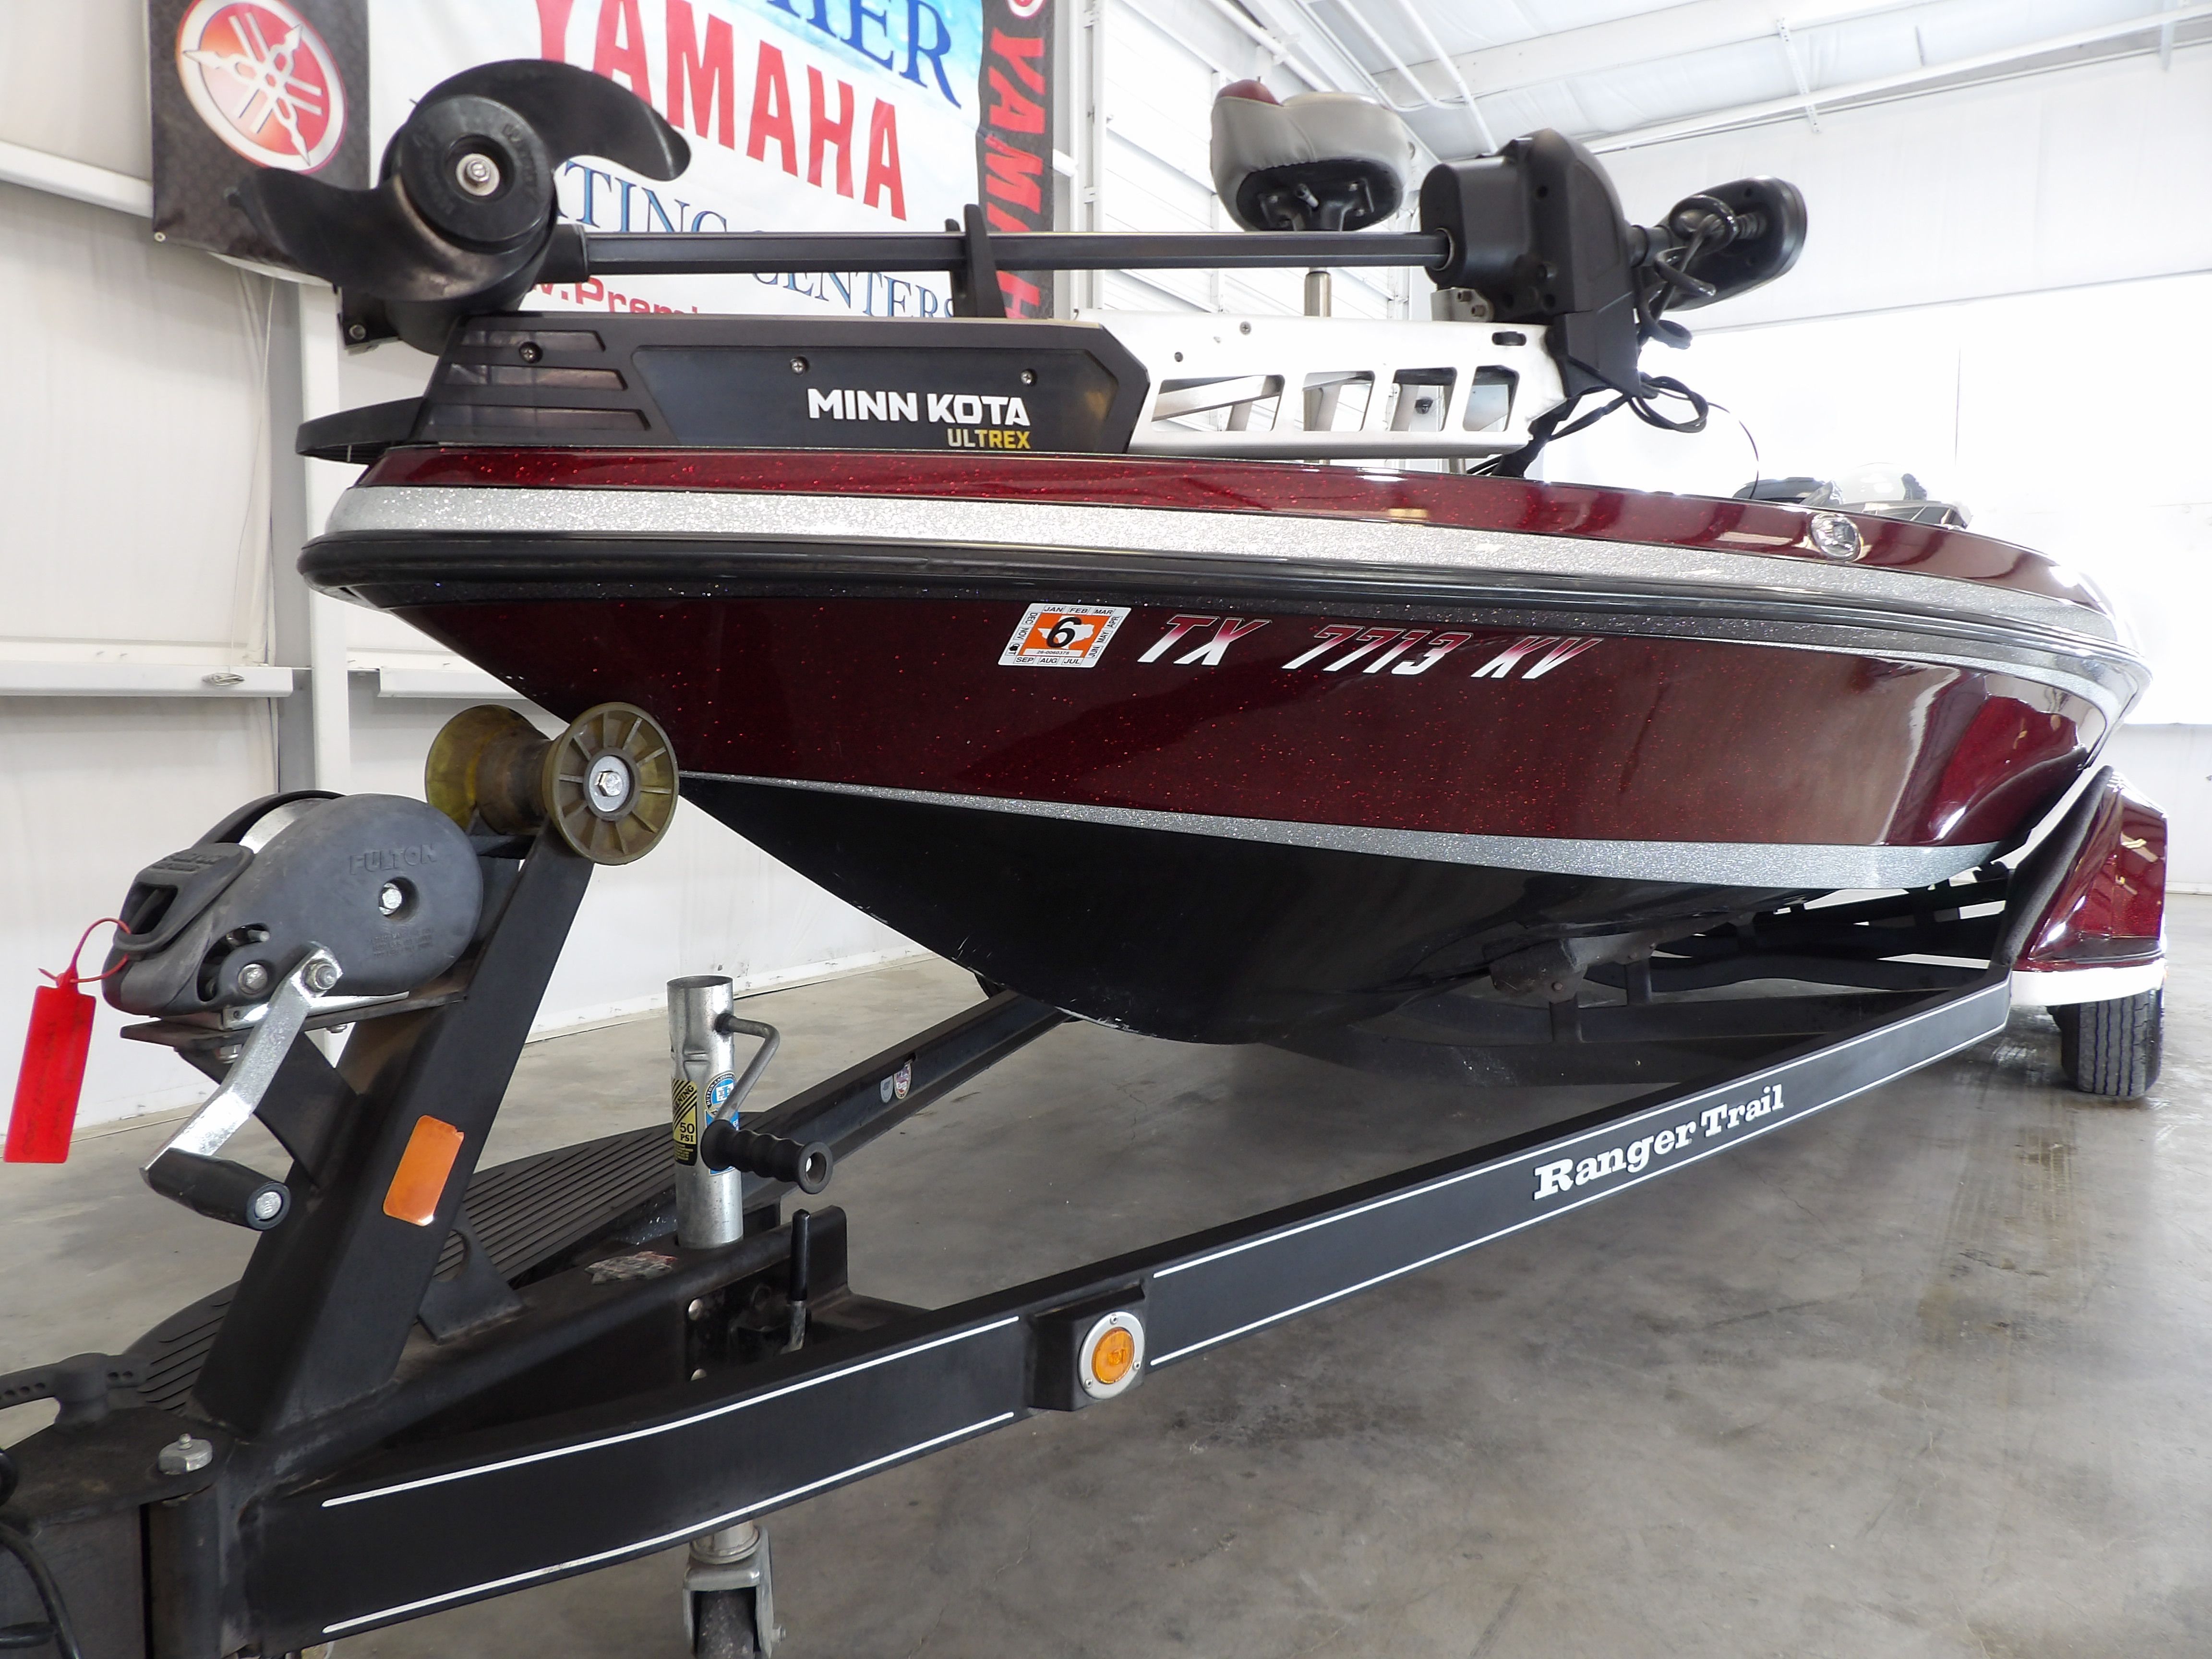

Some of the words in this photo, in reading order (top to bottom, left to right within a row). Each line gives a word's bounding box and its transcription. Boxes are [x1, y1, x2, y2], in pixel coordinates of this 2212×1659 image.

[807, 388, 918, 422] MINN
[927, 393, 1031, 426] KOTA
[947, 428, 1031, 450] ULTREX
[1025, 612, 1038, 624] DEC
[1108, 616, 1119, 628] APR
[1017, 628, 1029, 640] NOV
[1046, 616, 1082, 648] 6
[1097, 631, 1109, 643] MAY
[1008, 643, 1020, 655] OT
[1088, 646, 1100, 658] JUN
[1136, 613, 1272, 666] TX
[1282, 624, 1474, 675] 7713
[1470, 627, 1604, 679] KV
[349, 844, 437, 876] FULTON
[680, 1122, 695, 1134] 50
[680, 1134, 694, 1142] PSI
[1534, 1120, 1697, 1200] Ranger
[1700, 1083, 1785, 1137] Trail
